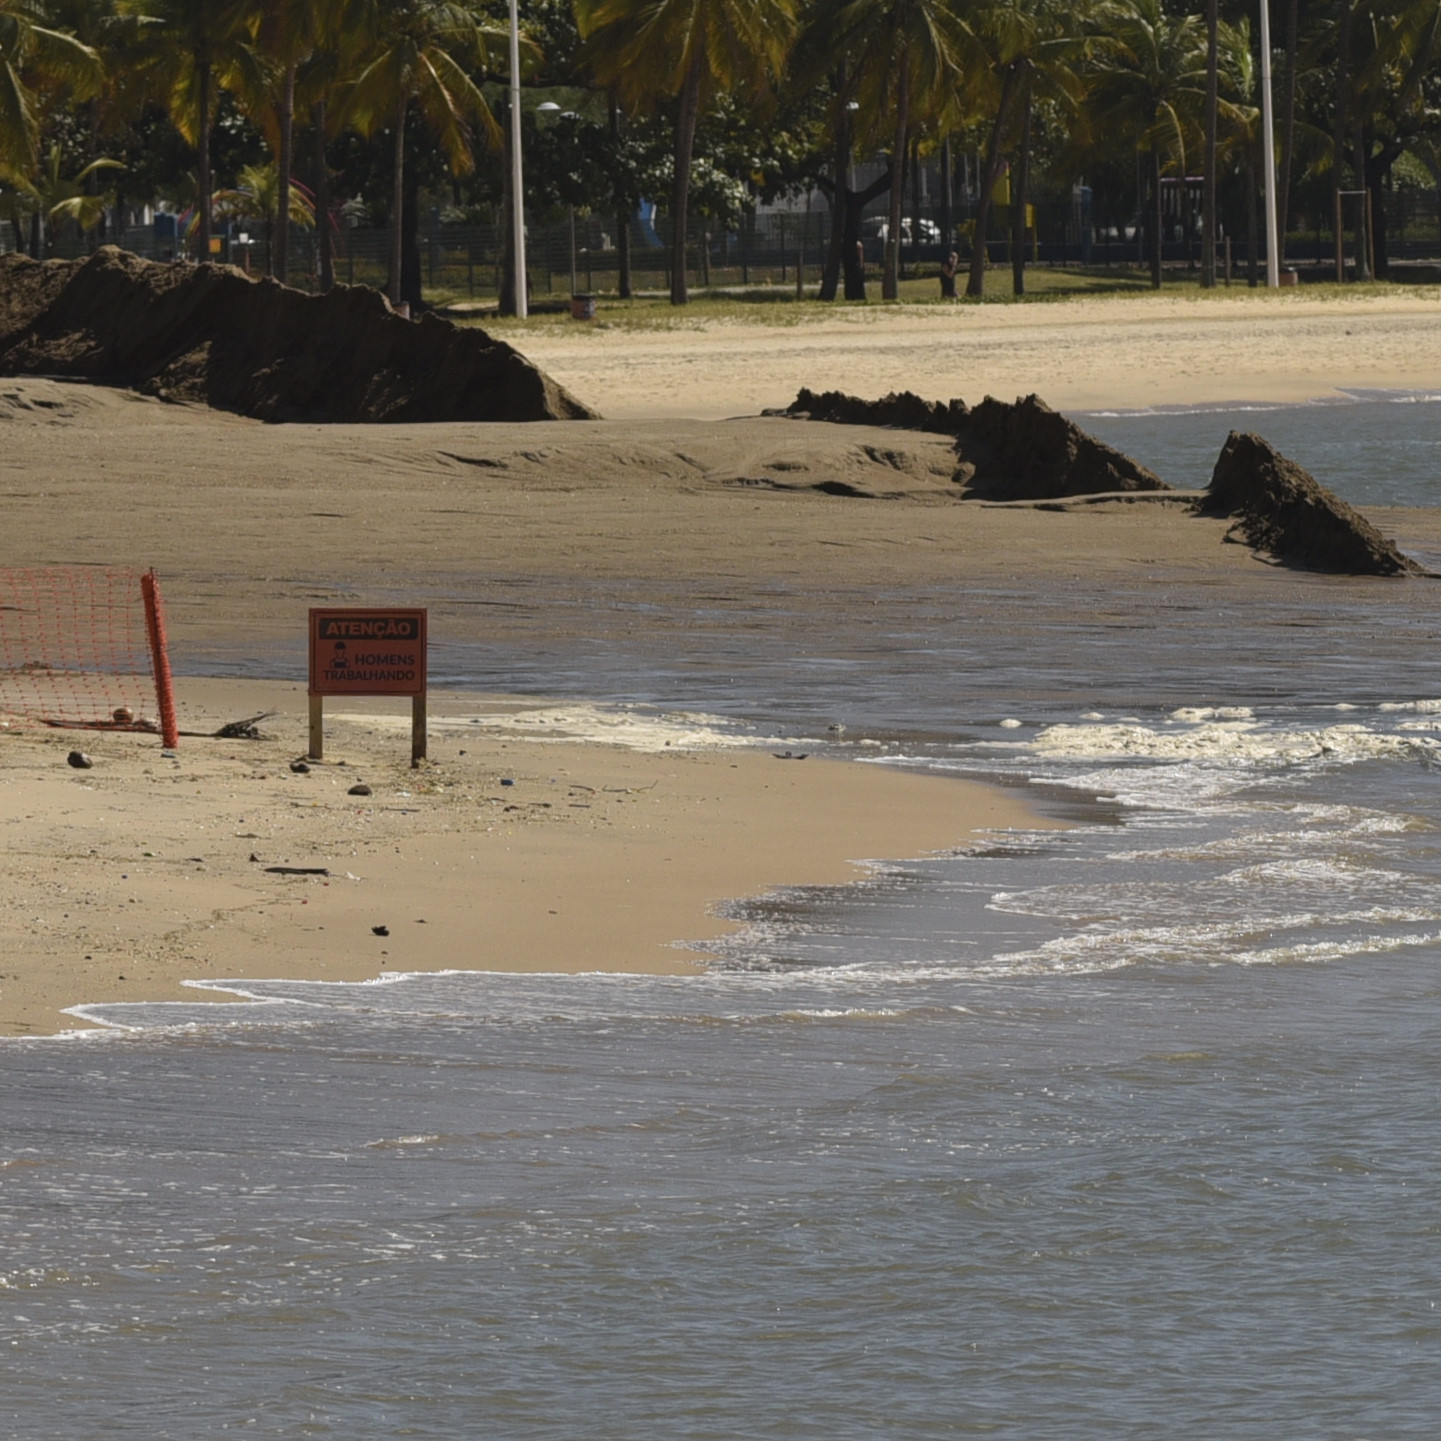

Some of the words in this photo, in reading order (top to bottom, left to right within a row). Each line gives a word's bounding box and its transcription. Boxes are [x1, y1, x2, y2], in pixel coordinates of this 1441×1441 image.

[326, 620, 411, 638] ATENÇÃO
[354, 654, 415, 665] HOMENS
[323, 670, 415, 681] TRABALHANDO
